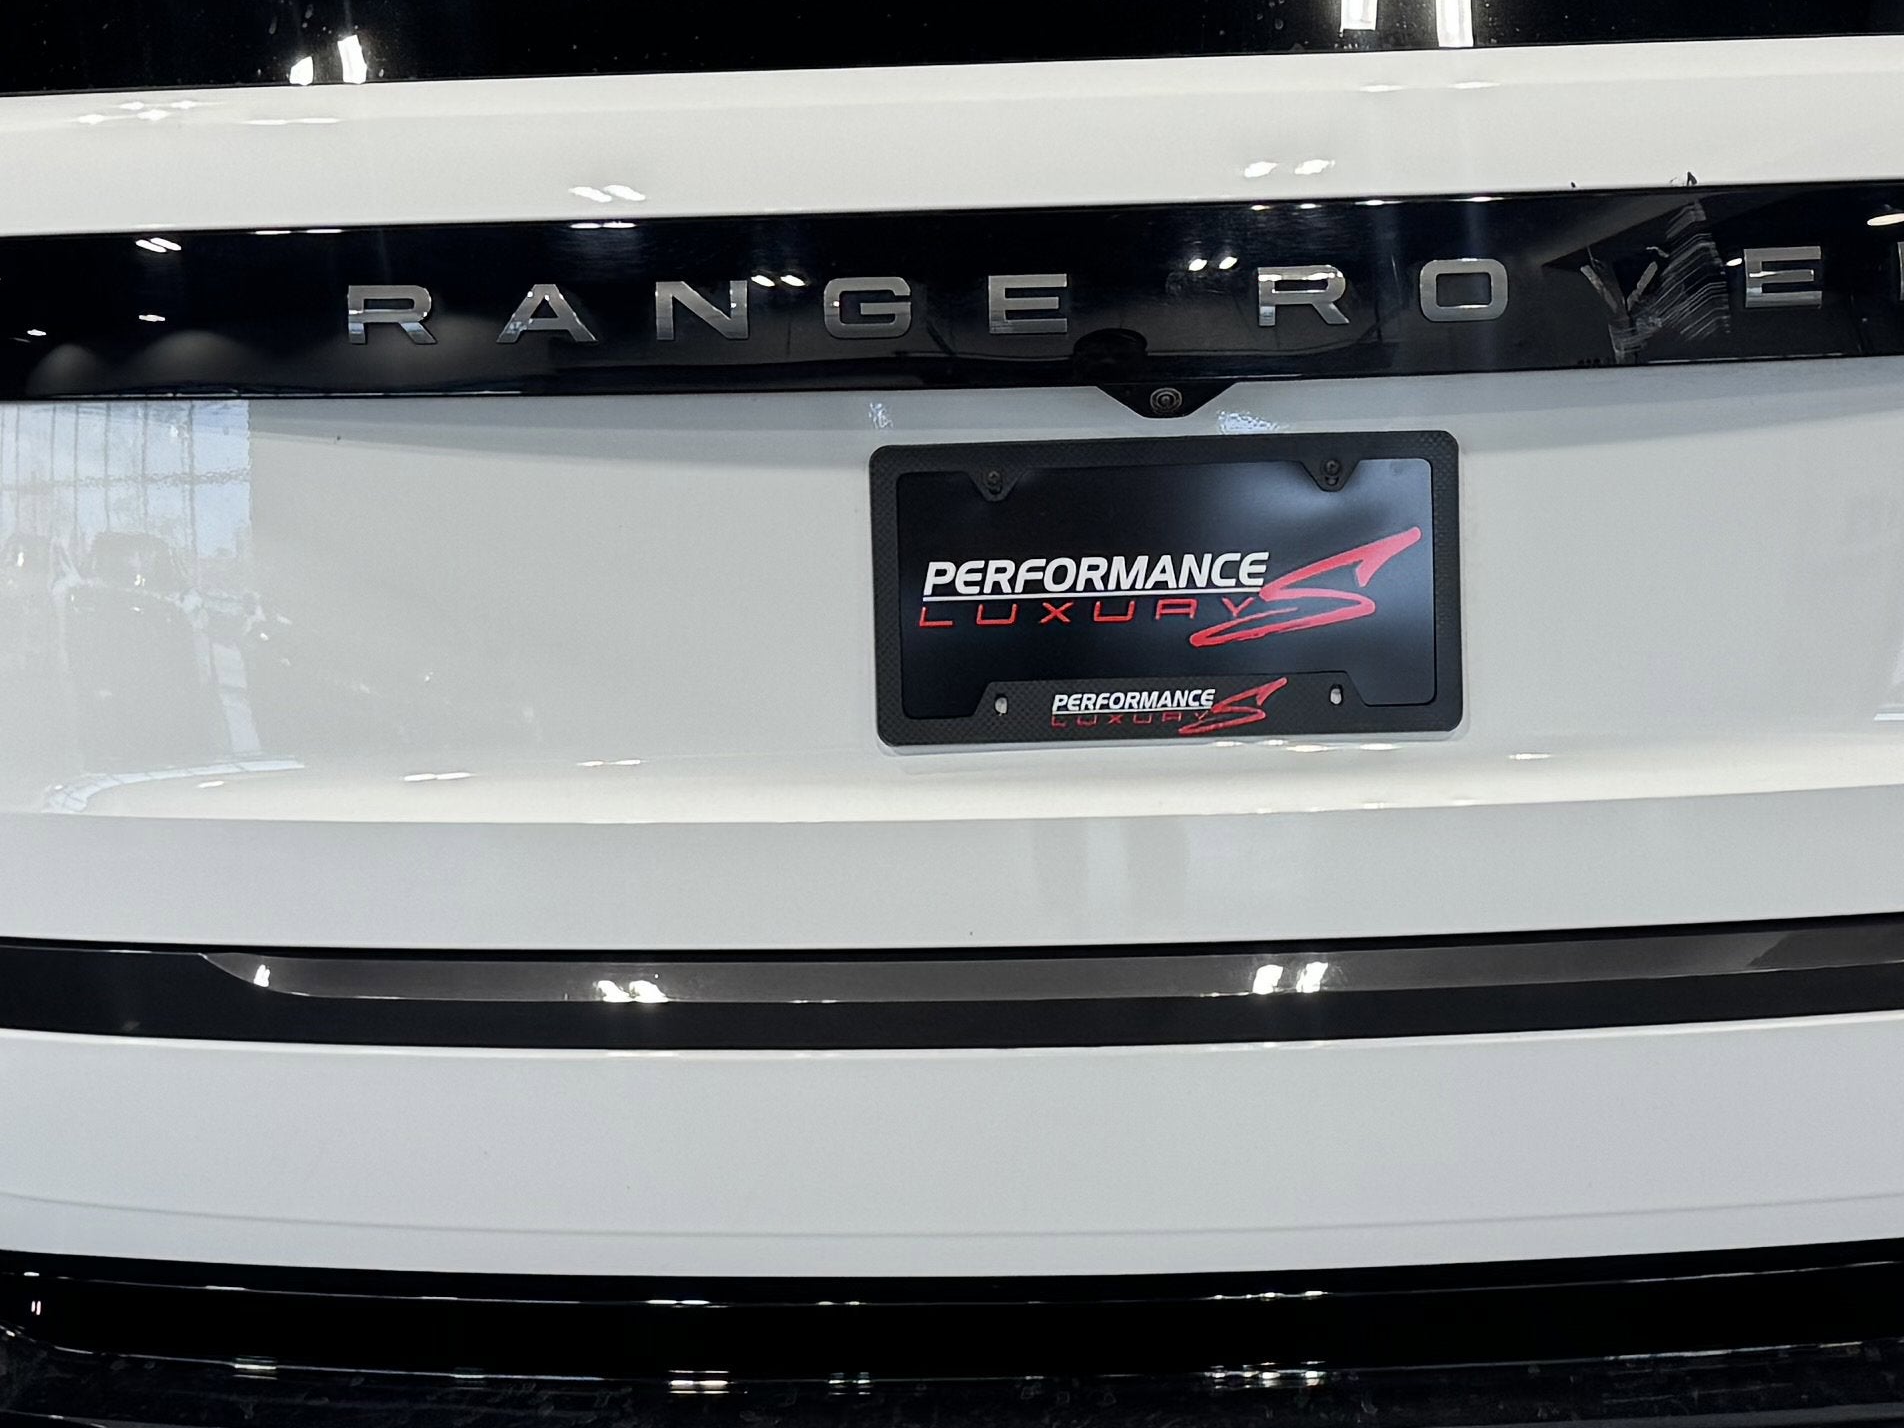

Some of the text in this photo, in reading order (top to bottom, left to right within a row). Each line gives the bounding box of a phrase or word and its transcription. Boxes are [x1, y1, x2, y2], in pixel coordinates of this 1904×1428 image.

[346, 273, 1069, 346] RANGE
[923, 551, 1270, 597] PERFORMANCE
[919, 596, 1255, 628] LUXURY
[1052, 688, 1216, 712] PERFORMANCE
[1051, 710, 1209, 728] LUXURY
